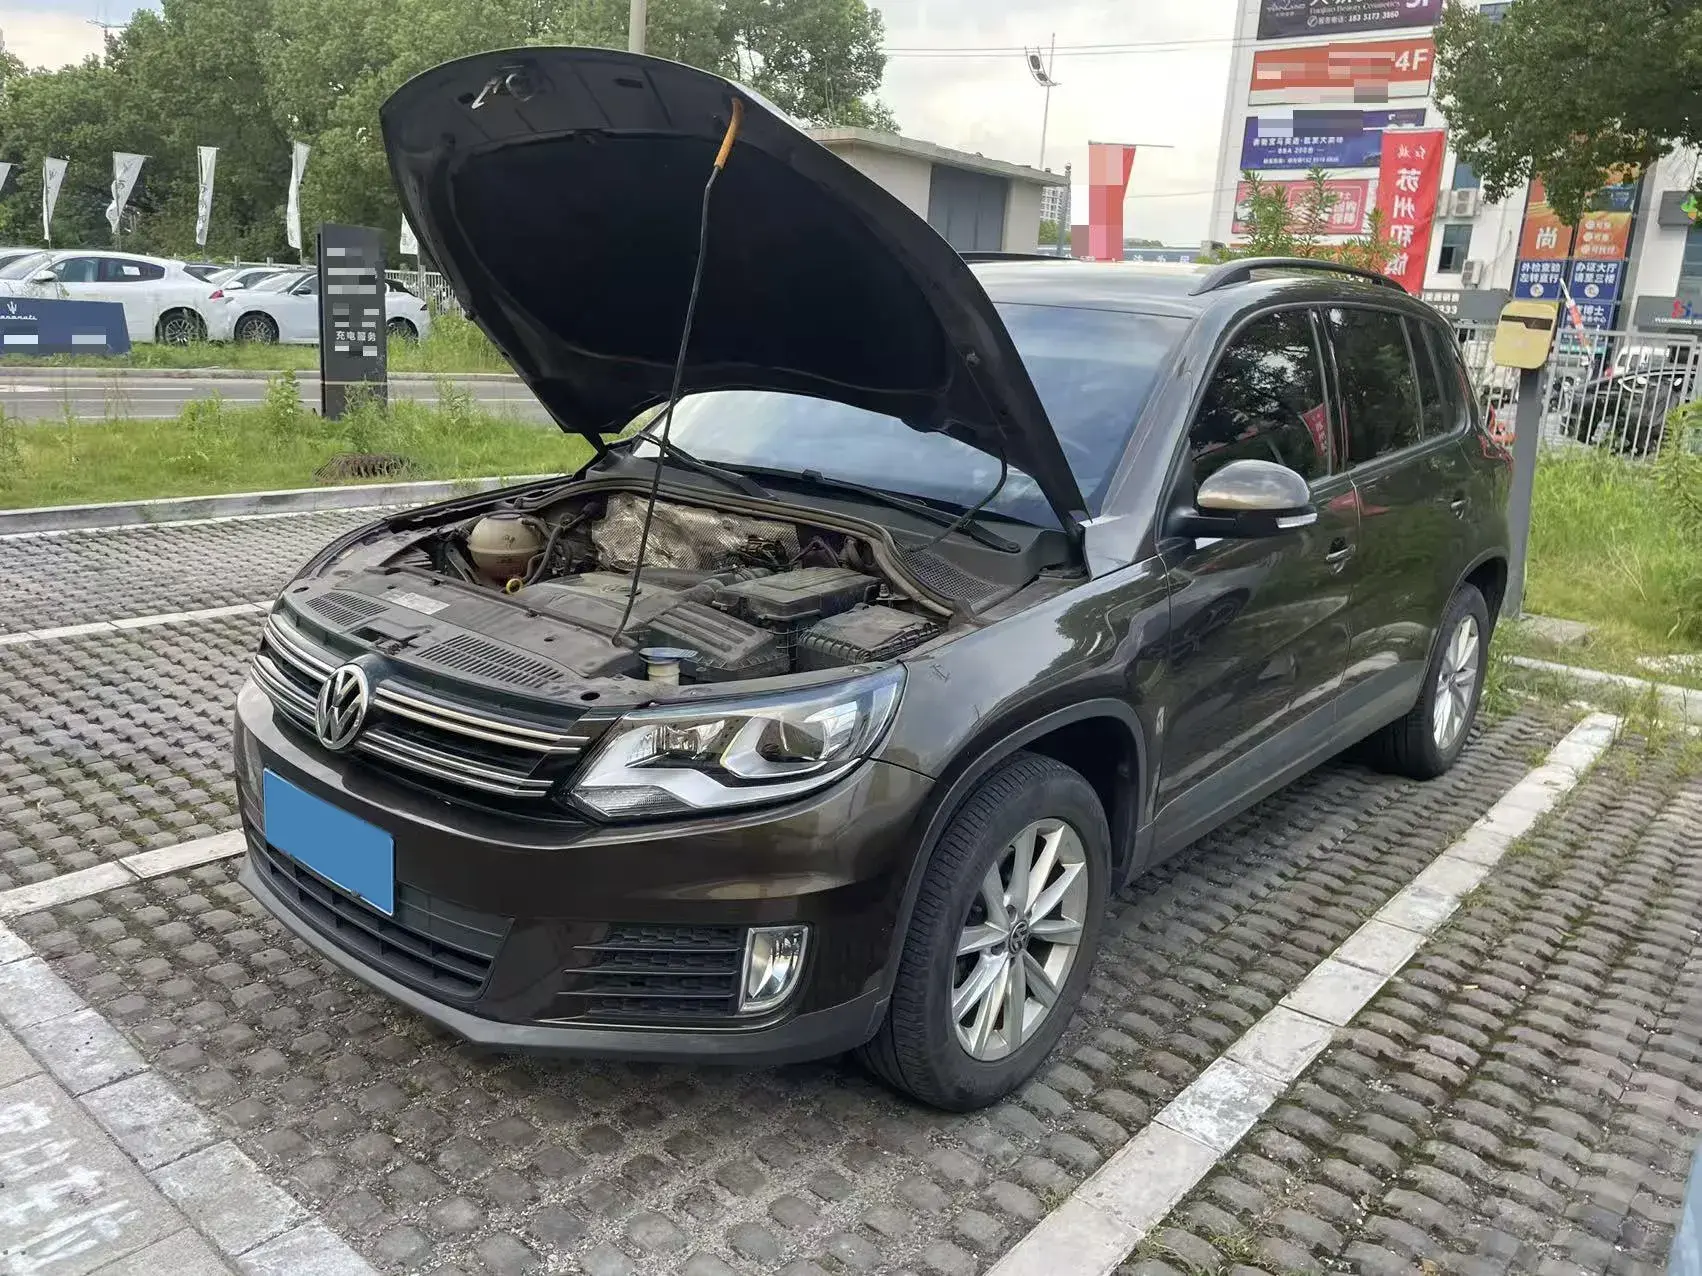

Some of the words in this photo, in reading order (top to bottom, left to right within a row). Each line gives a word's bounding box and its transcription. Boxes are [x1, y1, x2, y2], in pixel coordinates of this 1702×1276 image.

[1395, 48, 1429, 71] 4F
[335, 330, 376, 342] 充电服务
